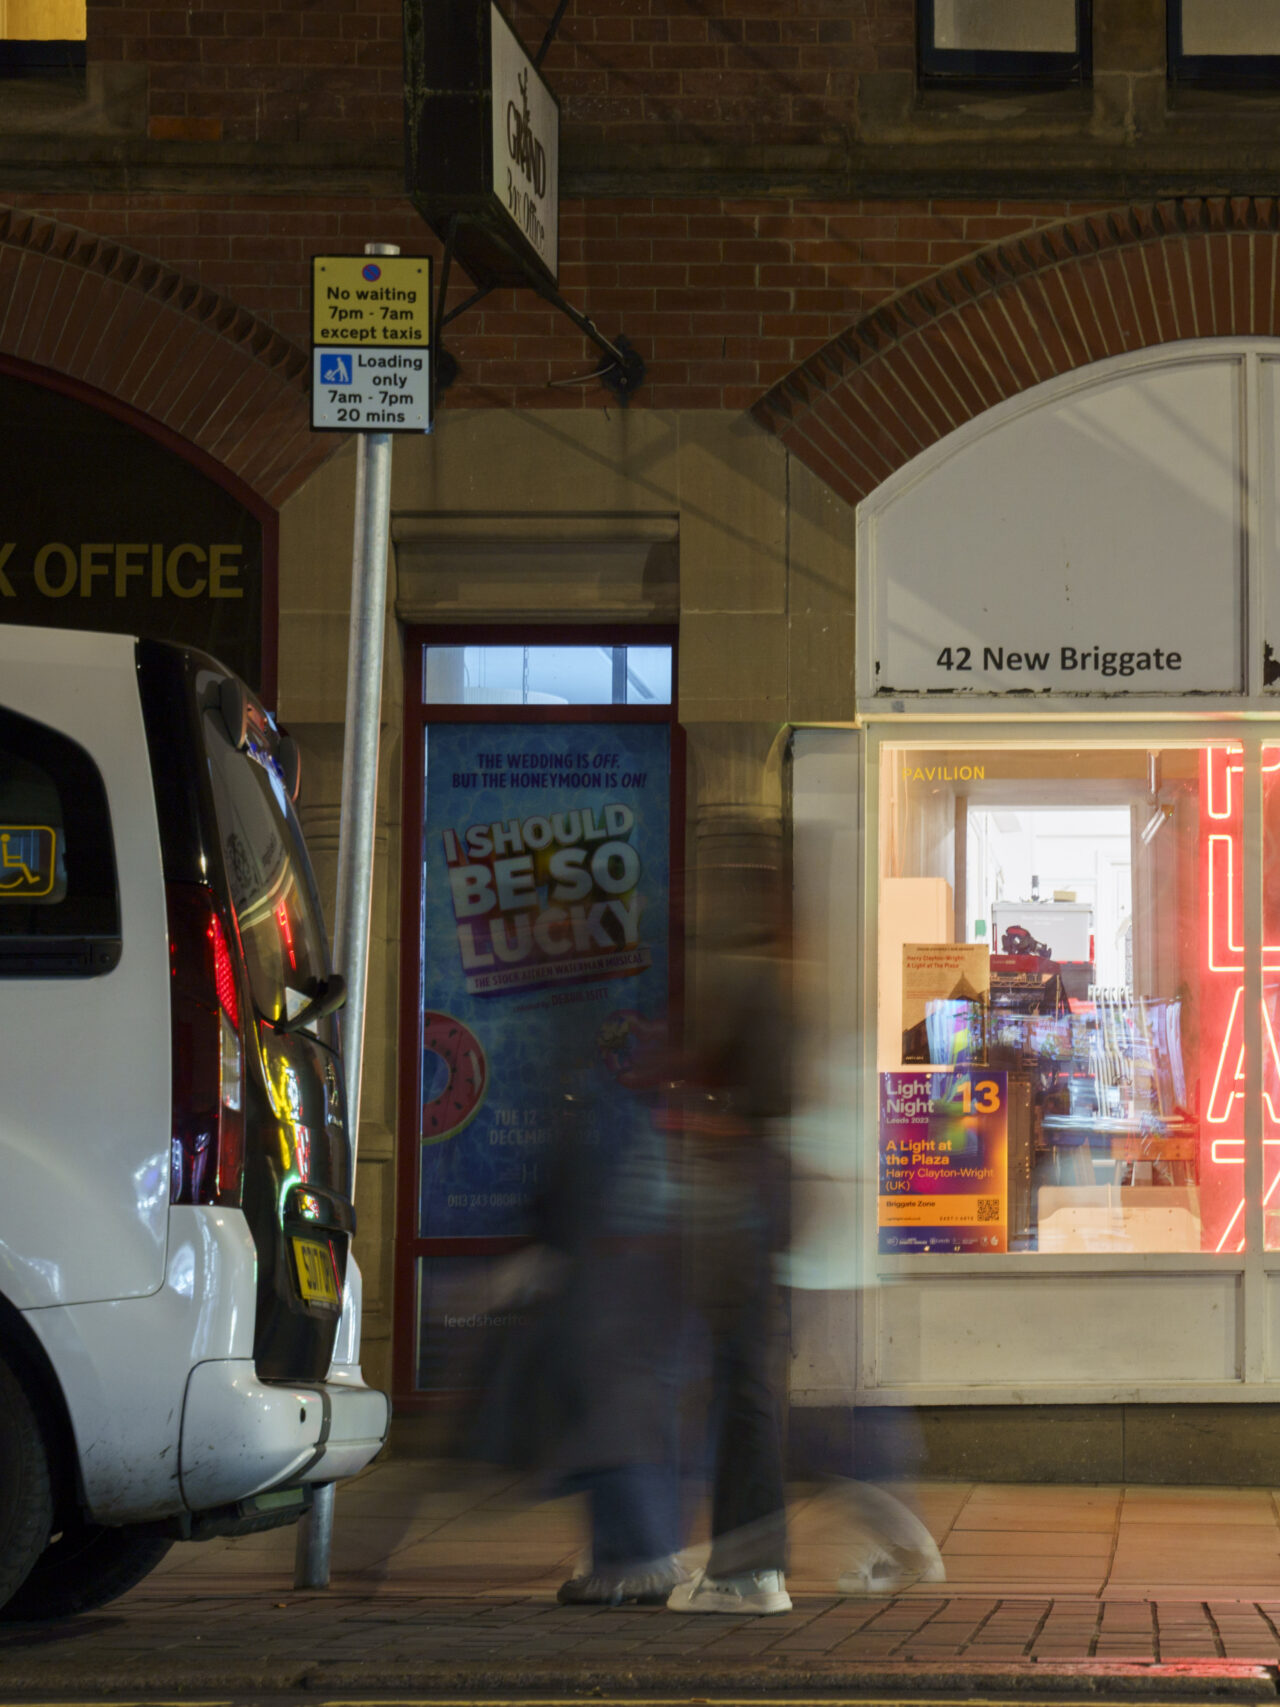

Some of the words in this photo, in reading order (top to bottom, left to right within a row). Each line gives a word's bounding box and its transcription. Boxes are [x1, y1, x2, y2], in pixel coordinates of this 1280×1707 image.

[506, 100, 546, 199] GRAND
[327, 286, 350, 300] No
[356, 287, 417, 304] waiting
[328, 306, 363, 322] 7pm
[380, 306, 413, 320] 7am
[320, 326, 377, 341] except
[382, 326, 422, 340] taxis
[358, 354, 423, 371] Loading
[372, 373, 408, 389] only
[328, 390, 362, 404] 7am
[379, 390, 413, 406] 7pm
[337, 408, 360, 422] 20
[366, 409, 405, 423] mins
[34, 542, 244, 598] OFFICE
[936, 647, 972, 671] 42
[983, 647, 1050, 671] New
[1060, 646, 1182, 676] Briggate
[477, 753, 503, 769] THE
[507, 753, 572, 769] WEDDING
[576, 753, 590, 769] IS
[593, 753, 621, 769] OFF.
[452, 773, 477, 788] BUT
[481, 773, 507, 788] THE
[510, 773, 601, 788] HONEYMOON
[605, 773, 617, 788] IS
[621, 772, 648, 788] ON!
[902, 765, 985, 782] PAVILION
[441, 828, 460, 864] I
[465, 803, 636, 858] SHOULD
[449, 854, 539, 920] BE
[550, 840, 642, 901] SO
[456, 900, 645, 972] LUCKY
[886, 1079, 932, 1100] Light
[957, 1080, 1000, 1114] 13
[886, 1099, 935, 1117] Night
[886, 1117, 910, 1125] Leeds
[886, 1140, 897, 1151] A
[900, 1139, 936, 1154] Light
[938, 1140, 952, 1151] at
[886, 1154, 909, 1165] the
[911, 1154, 950, 1165] Plaza
[886, 1168, 915, 1179] Harry
[917, 1167, 994, 1179] Clayton-Wright
[885, 1180, 911, 1192] (UK)
[886, 1200, 916, 1210] Briggate
[917, 1200, 936, 1208] Zone
